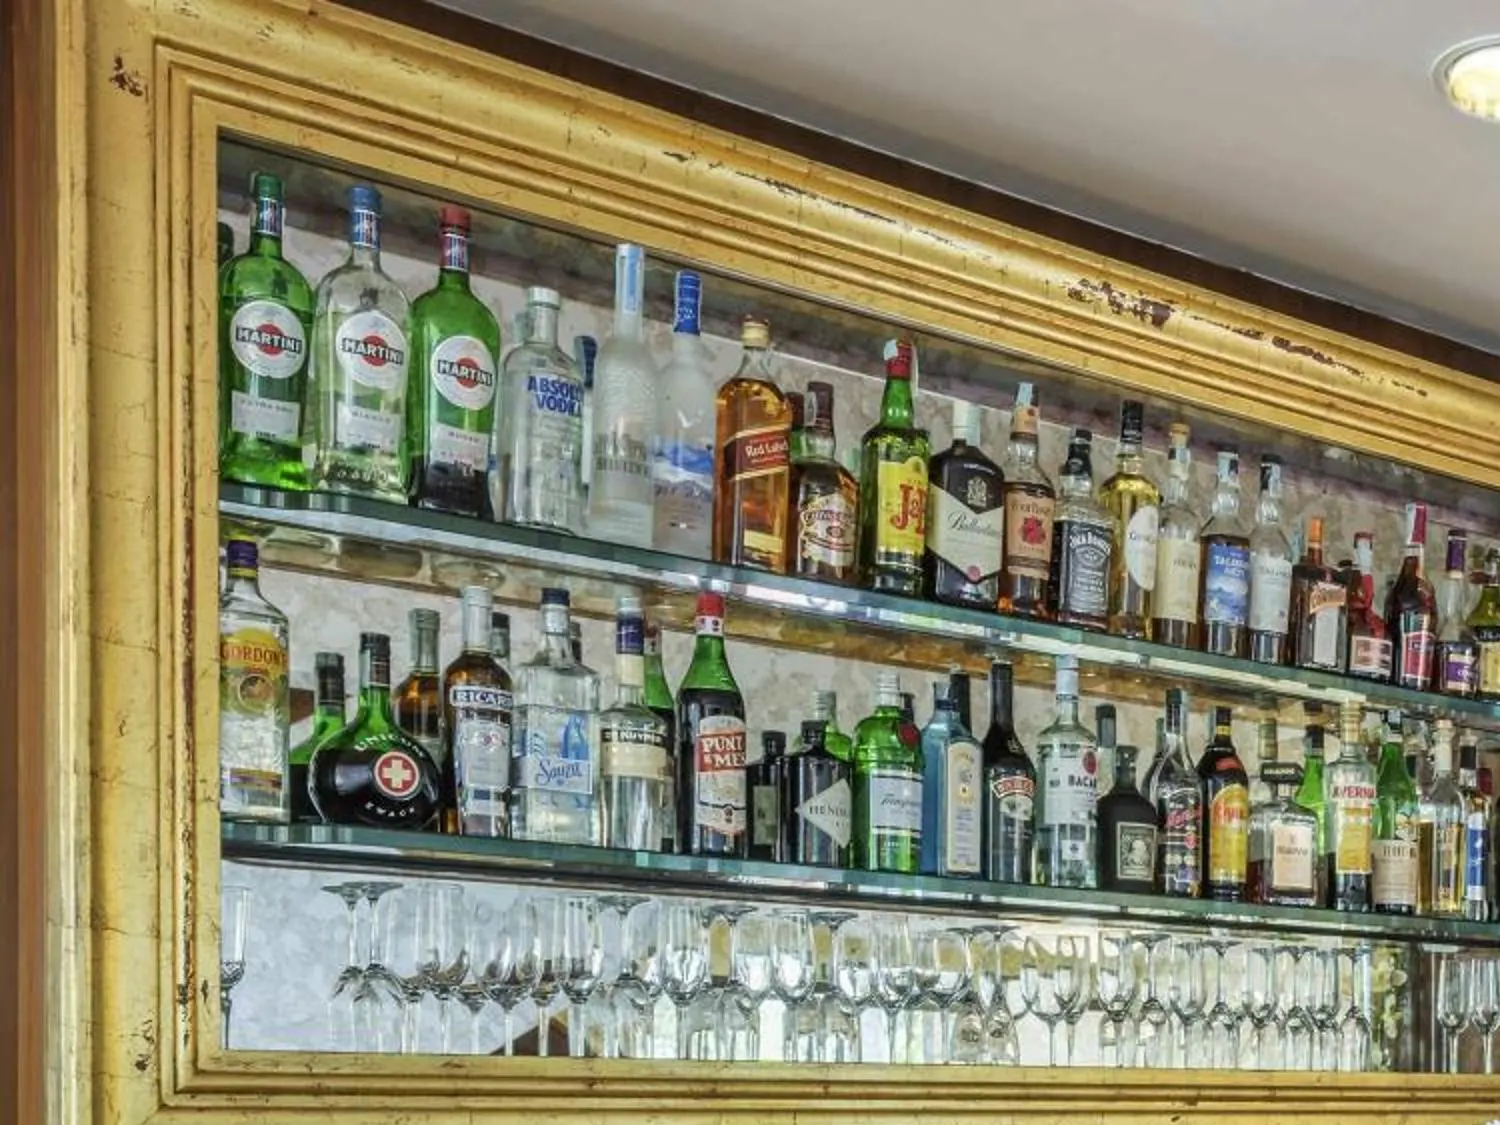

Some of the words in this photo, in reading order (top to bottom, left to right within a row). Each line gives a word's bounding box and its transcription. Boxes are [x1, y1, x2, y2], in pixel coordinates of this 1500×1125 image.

[236, 325, 303, 355] MARTINI
[342, 338, 404, 365] MARTINI
[437, 359, 493, 387] MARTINI
[745, 443, 766, 457] Red
